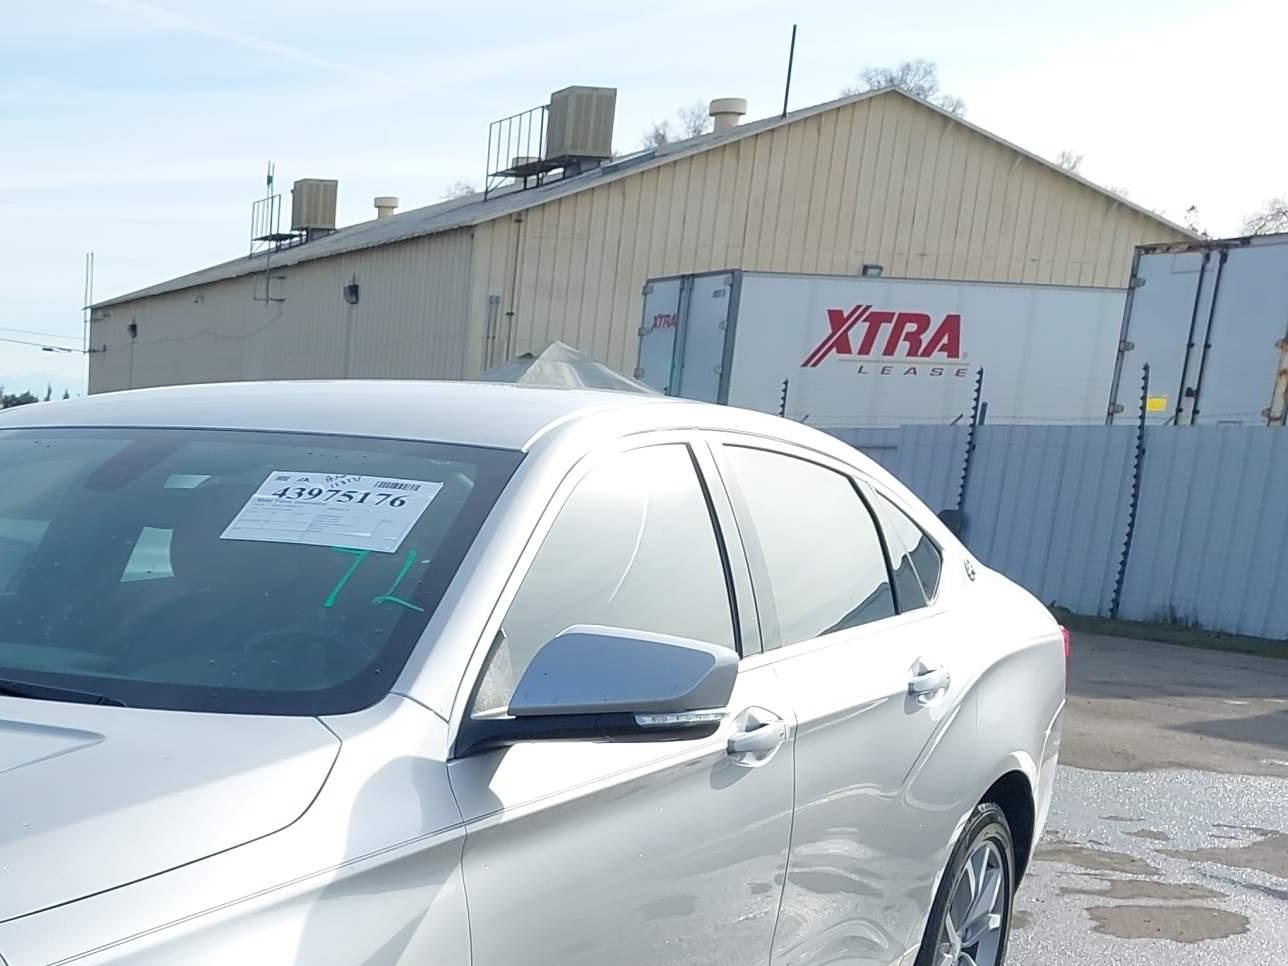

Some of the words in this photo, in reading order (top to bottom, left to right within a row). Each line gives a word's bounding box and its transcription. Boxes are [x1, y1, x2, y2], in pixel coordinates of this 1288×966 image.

[801, 304, 961, 368] XTRA
[857, 365, 969, 378] LEASE
[271, 486, 408, 508] 43975176
